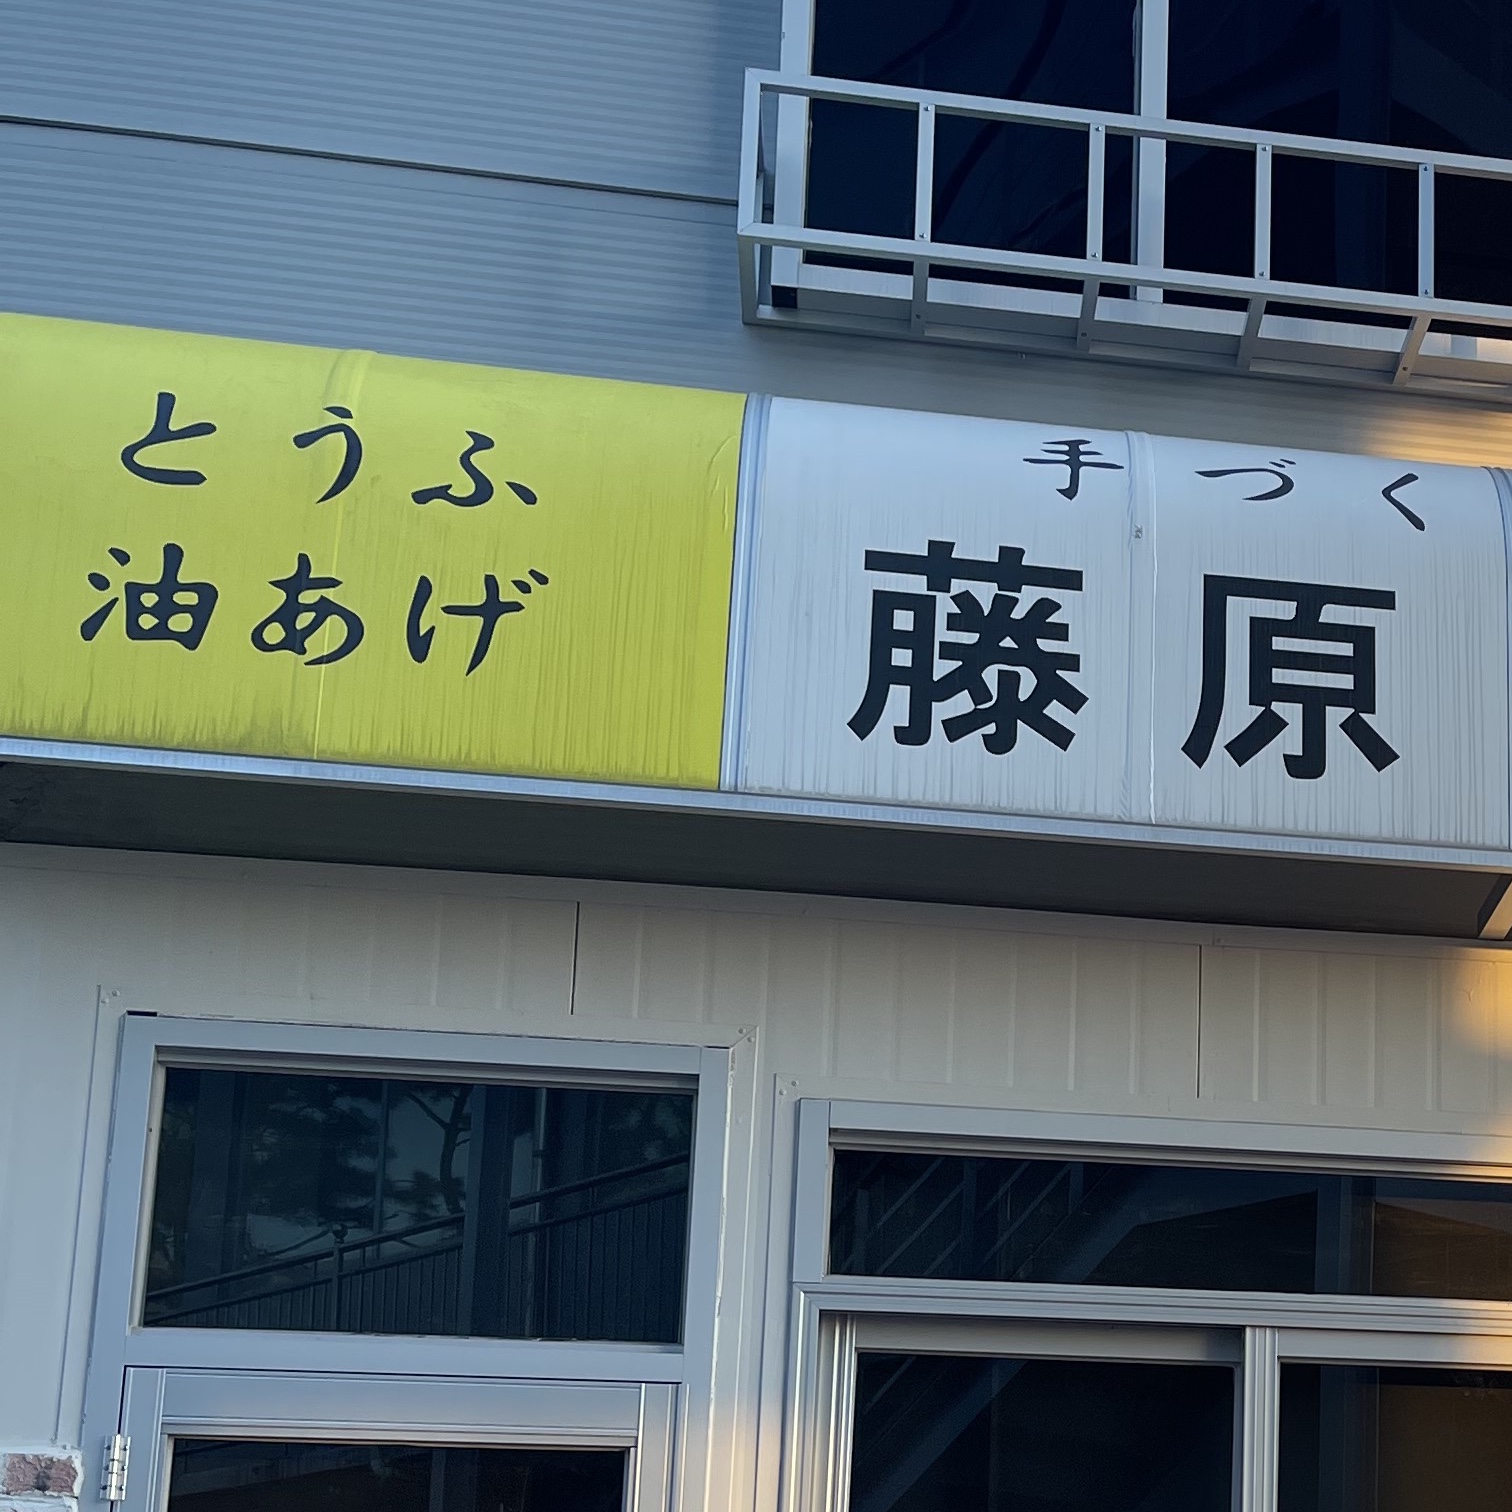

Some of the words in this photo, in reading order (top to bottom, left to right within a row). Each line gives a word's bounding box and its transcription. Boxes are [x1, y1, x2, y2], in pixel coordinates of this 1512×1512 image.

[121, 392, 538, 507] とうふ
[80, 542, 550, 677] 油あげ
